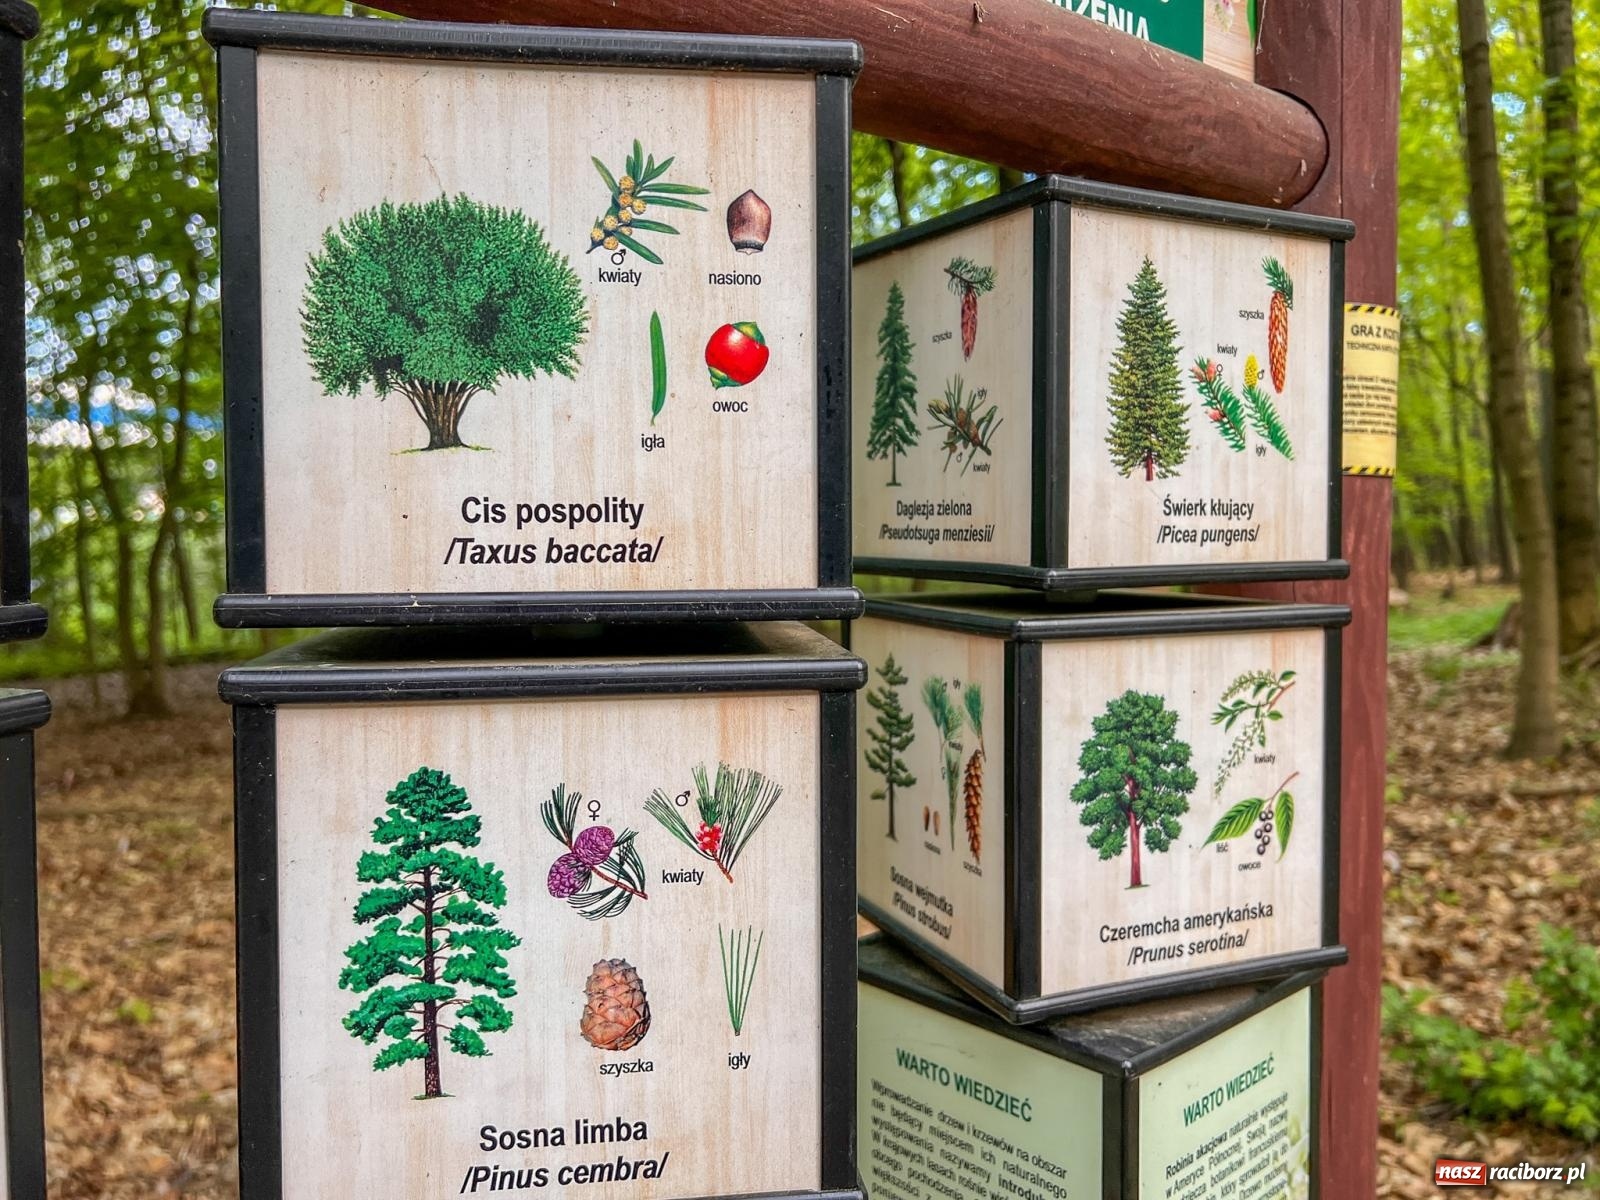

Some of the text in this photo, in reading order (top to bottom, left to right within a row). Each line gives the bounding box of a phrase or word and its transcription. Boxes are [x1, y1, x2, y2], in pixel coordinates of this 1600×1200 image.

[599, 268, 642, 287] kwiaty
[708, 270, 762, 286] nasiono
[1239, 308, 1264, 321] szyszka
[1217, 343, 1238, 357] kwiaty
[712, 401, 749, 413] owoc
[641, 433, 665, 452] igła
[1256, 444, 1267, 457] igły
[973, 462, 990, 474] kwiaty
[461, 496, 645, 530] Cis pospolity
[896, 499, 972, 520] Daglezja zielona
[1163, 493, 1254, 520] Świerk kłujący
[879, 523, 995, 544] /Pseudotsuga menziesii/
[1157, 524, 1261, 547] /Picea pungens/
[443, 536, 664, 565] /Taxus baccata/
[1254, 753, 1275, 765] kwiaty
[661, 868, 705, 885] kwiaty
[1100, 902, 1273, 943] Czeremcha amerykańska
[1127, 929, 1250, 966] /Prunus serotina/
[599, 1058, 654, 1078] szyszka
[728, 1053, 751, 1070] igły
[896, 1048, 1032, 1122] WARTO WIEDZIEĆ
[1183, 1052, 1274, 1127] WARTO WIEDZIEĆ
[479, 1116, 648, 1151] Sosna limba
[972, 1124, 1014, 1155] krzewów
[1016, 1148, 1029, 1162] na
[1032, 1154, 1067, 1179] obszar
[459, 1152, 670, 1194] /Pinus cembra/
[1166, 1152, 1194, 1180] Robinia
[1002, 1160, 1067, 1200] naturalnego
